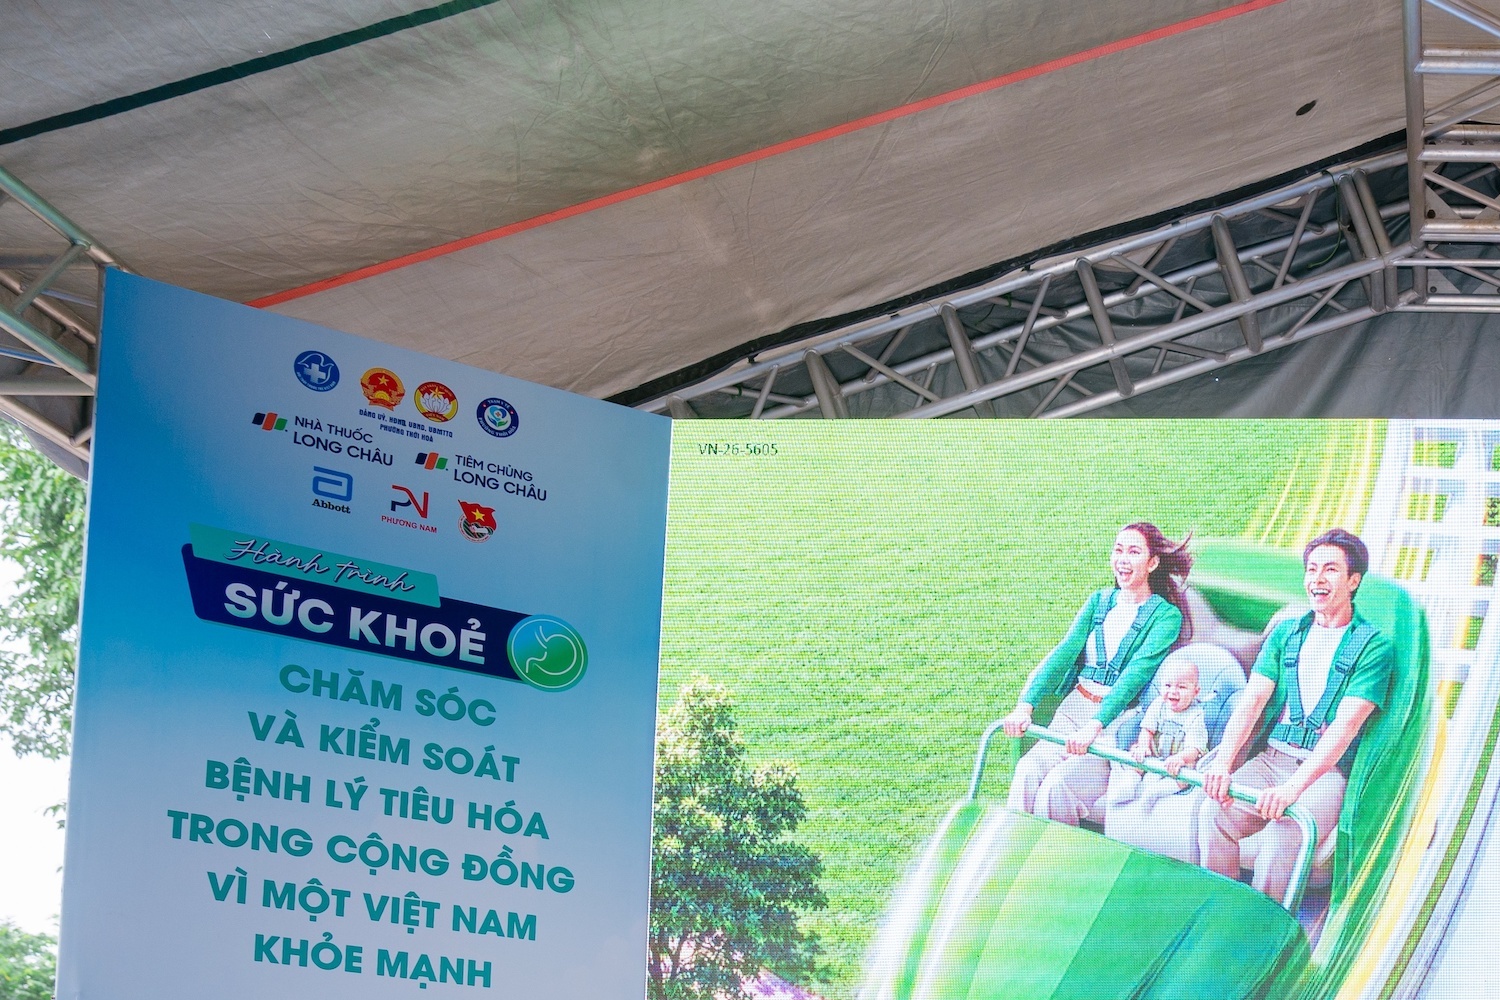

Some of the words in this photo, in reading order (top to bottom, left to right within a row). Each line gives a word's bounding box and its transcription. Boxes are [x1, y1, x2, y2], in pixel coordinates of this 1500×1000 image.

[293, 431, 343, 454] LONG
[347, 445, 393, 466] CHÂU
[295, 416, 323, 432] NHÀ
[327, 424, 373, 444] THUỐC
[698, 443, 778, 455] VN-26-5605
[453, 468, 500, 490] LONG
[503, 481, 547, 501] CHÂU
[455, 454, 484, 470] TIÊM
[487, 463, 533, 482] CHỦNG
[312, 499, 351, 514] Abbott
[381, 515, 418, 529] PHƯƠNG
[420, 521, 438, 534] NAM
[223, 581, 335, 634] SỨC
[349, 608, 487, 666] KHOẺ
[279, 664, 402, 712] CHĂM
[415, 686, 497, 727] SÓC
[247, 709, 305, 749] VÀ
[319, 716, 410, 766] KIỂM
[423, 741, 520, 784] SOÁT
[204, 757, 311, 804] BỆNH
[325, 775, 370, 812] LÝ
[380, 786, 455, 825] TIÊU
[467, 796, 551, 840] HÓA
[166, 809, 314, 859] TRONG
[326, 832, 449, 878] CỘNG
[461, 844, 575, 894] ĐỒNG
[207, 866, 247, 905] VÌ
[262, 877, 351, 924] MỘT
[363, 891, 442, 935] VIỆT
[452, 904, 538, 941] NAM
[254, 930, 364, 974] KHỎE
[376, 949, 493, 990] MẠNH
